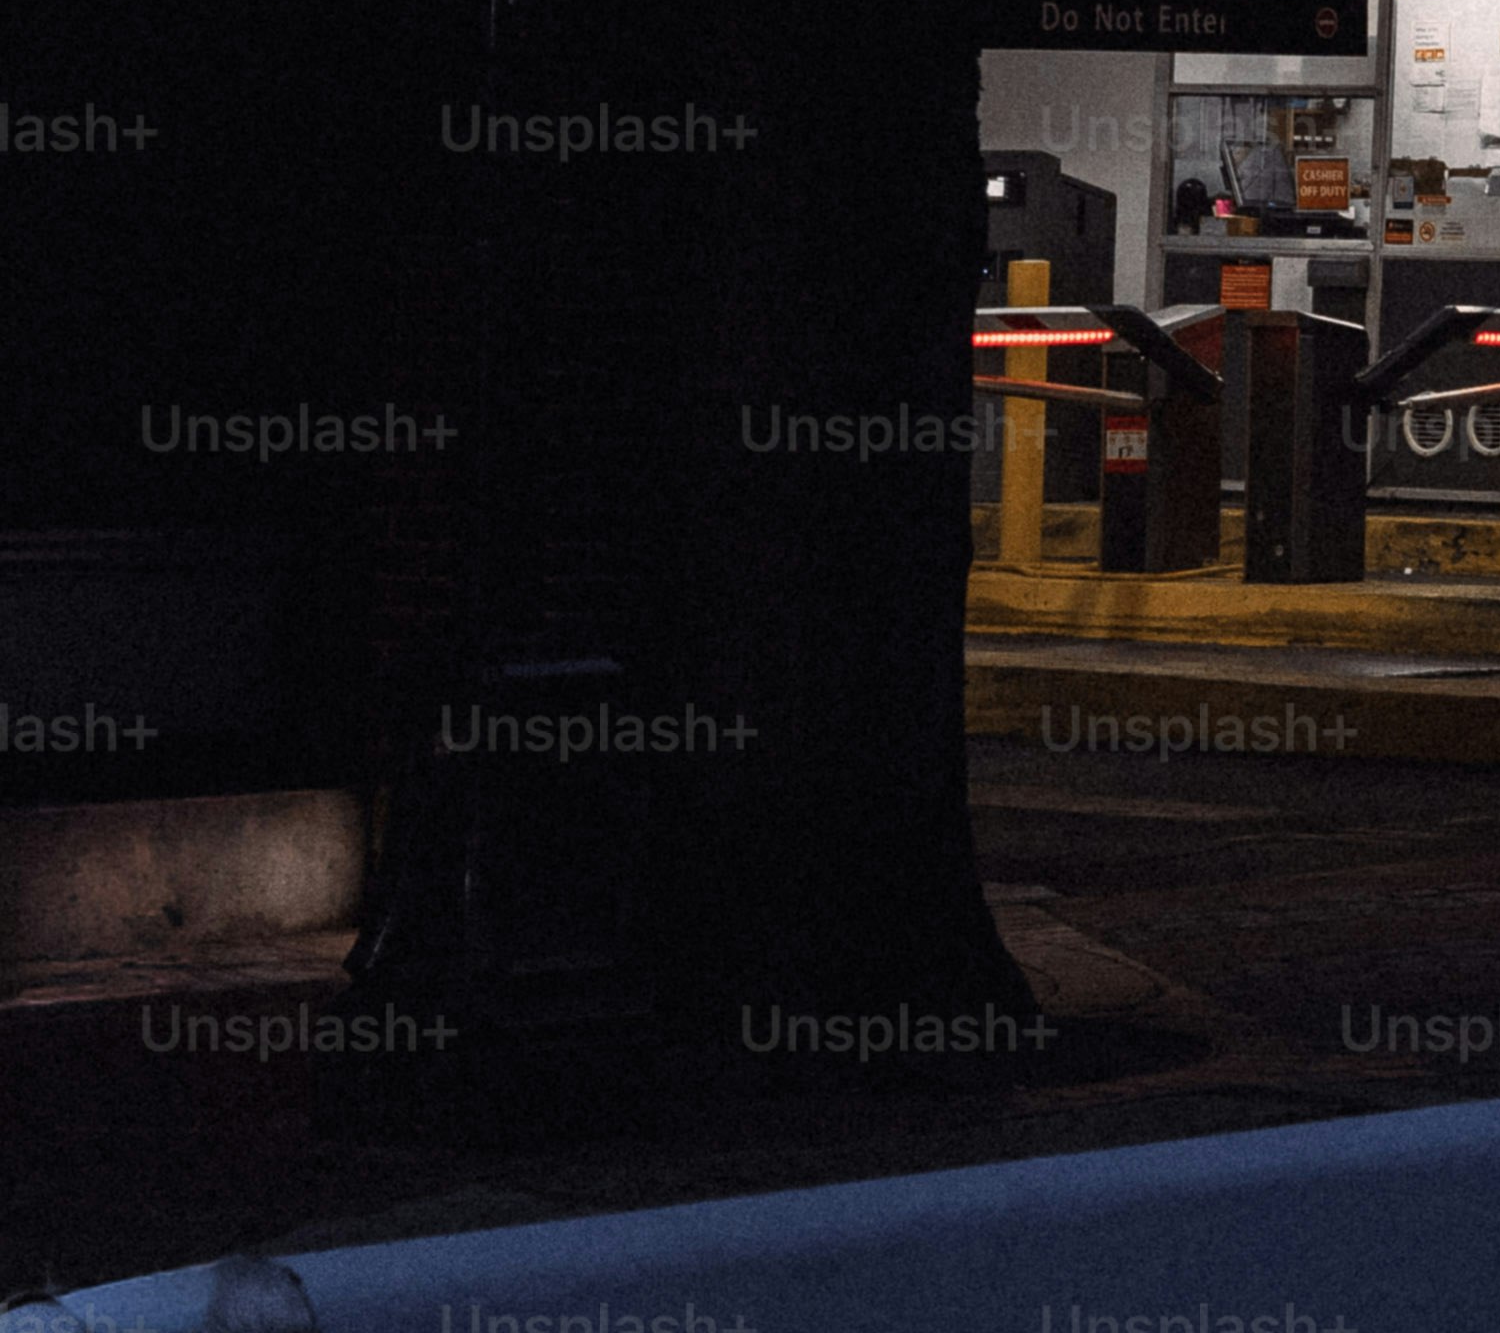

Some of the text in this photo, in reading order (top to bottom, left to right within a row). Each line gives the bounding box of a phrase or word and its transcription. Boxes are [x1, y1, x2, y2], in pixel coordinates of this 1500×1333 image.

[1041, 1, 1079, 31] Do
[1094, 3, 1144, 32] Not
[1302, 169, 1345, 182] CASHIER
[1299, 184, 1347, 198] OFF DUTY
